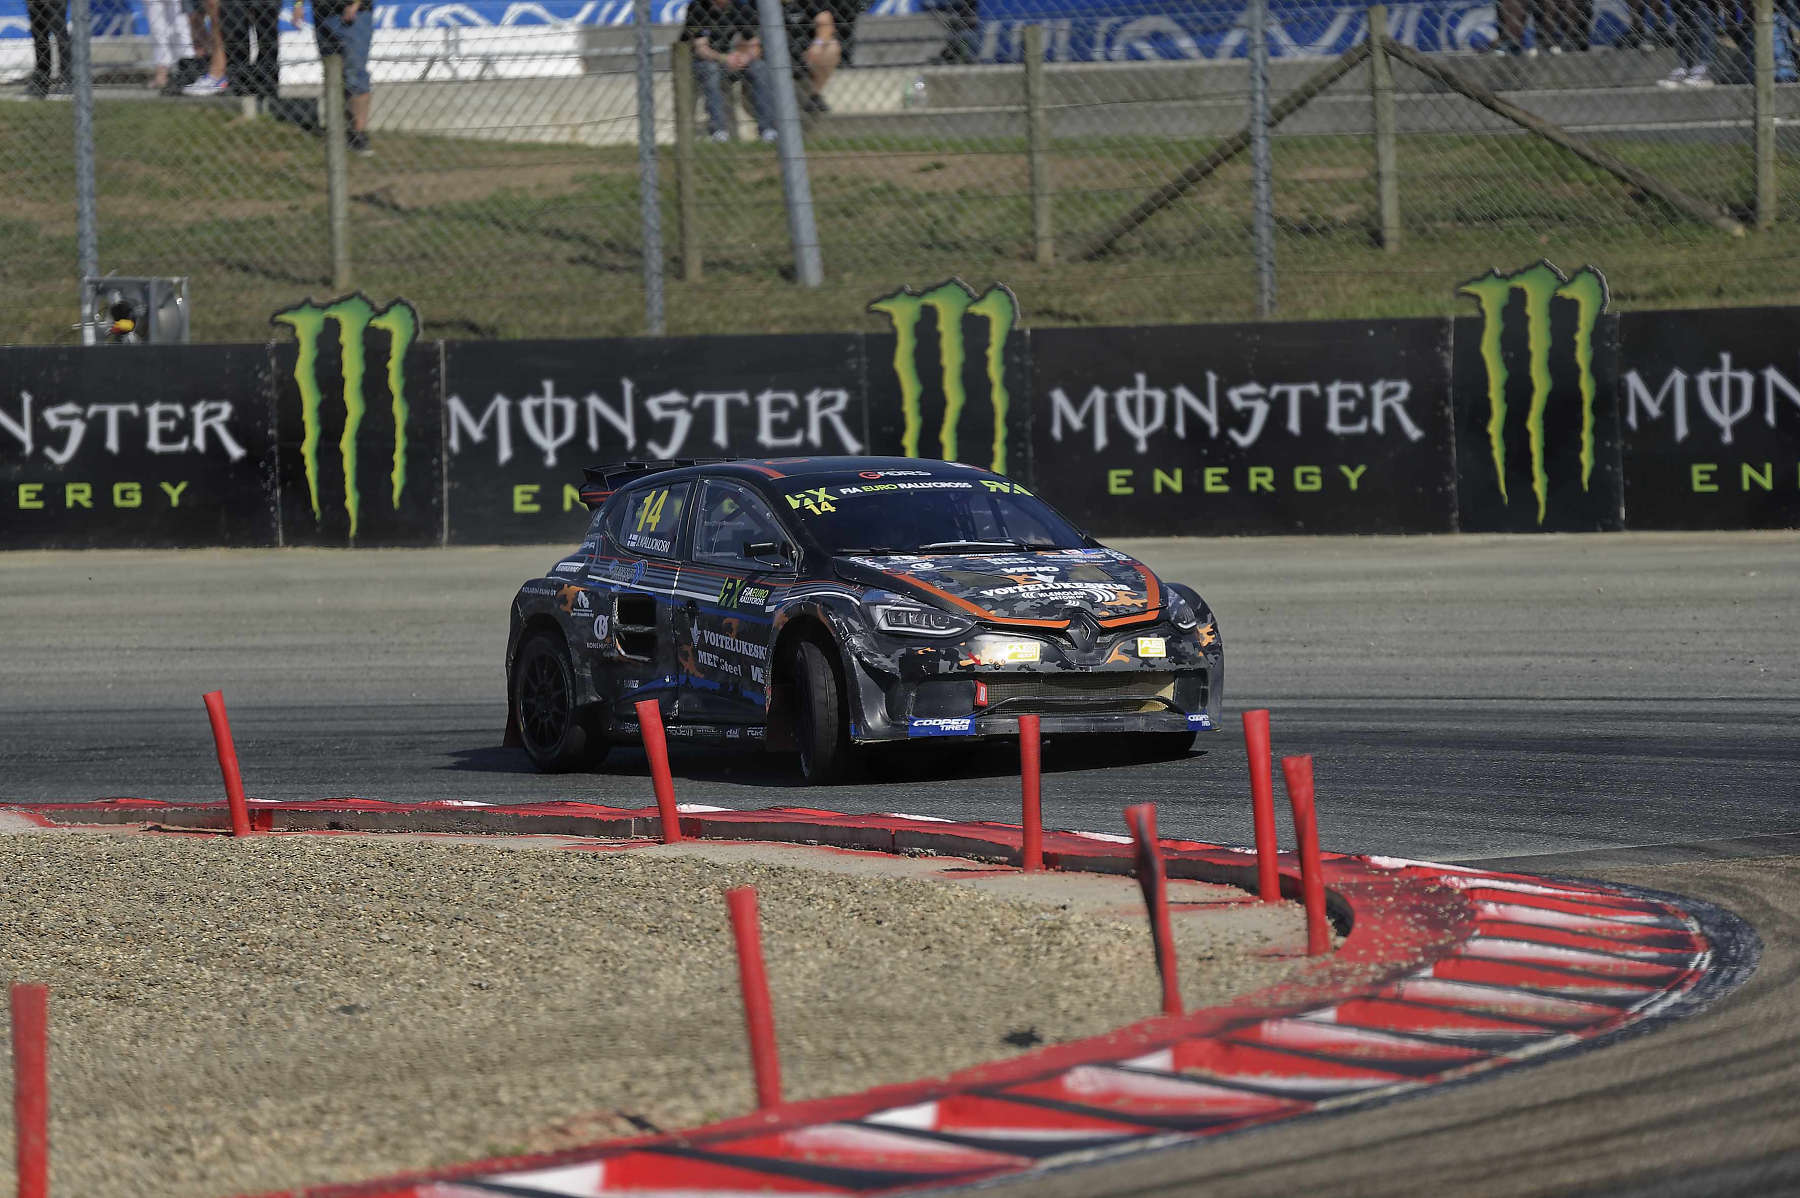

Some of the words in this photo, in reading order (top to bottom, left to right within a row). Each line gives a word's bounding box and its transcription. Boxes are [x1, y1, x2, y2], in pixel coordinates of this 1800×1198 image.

[446, 377, 864, 467] MONSTER
[1049, 370, 1425, 453] MONSTER
[839, 487, 863, 495] FIA
[861, 483, 898, 493] EURO
[897, 482, 973, 491] RALLYCROSS
[1108, 464, 1368, 495] ENERGY
[1691, 461, 1800, 492] EN
[18, 481, 188, 508] ERGY
[637, 490, 669, 532] 14
[805, 501, 837, 516] 14
[980, 582, 1132, 597] VOITELUKESKUS
[720, 658, 743, 677] Steel
[913, 718, 971, 727] COOPER
